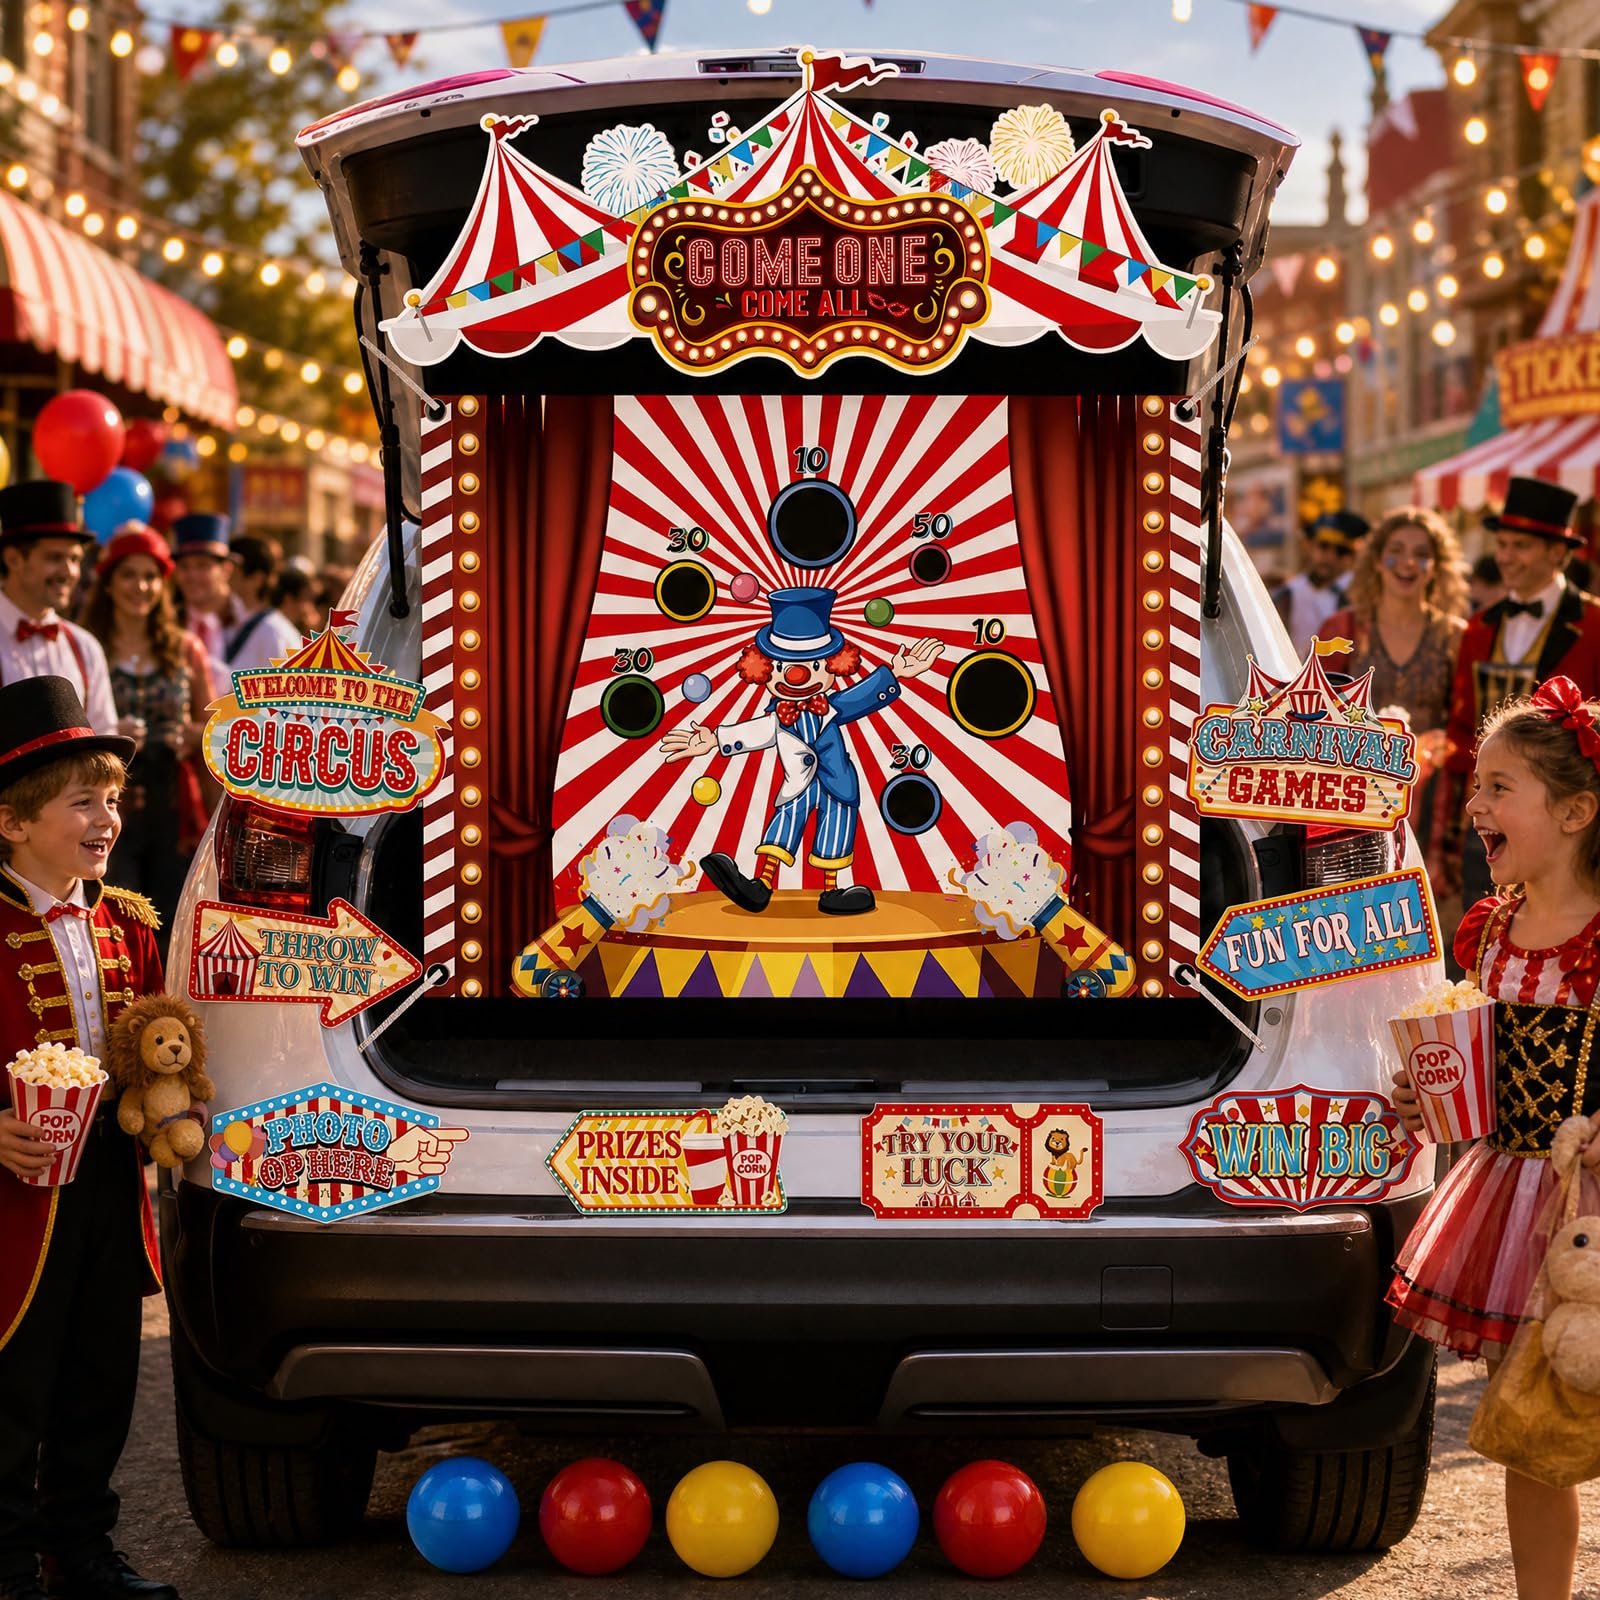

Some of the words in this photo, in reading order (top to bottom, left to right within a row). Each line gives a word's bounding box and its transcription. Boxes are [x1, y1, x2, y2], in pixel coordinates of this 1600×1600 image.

[688, 237, 822, 287] COME
[835, 236, 928, 286] ONE
[741, 290, 809, 317] COME
[818, 290, 868, 317] ALL
[794, 447, 828, 473] 10
[912, 512, 953, 539] 50
[667, 527, 709, 553] 30
[972, 618, 1007, 645] 10
[613, 648, 654, 673] 30
[241, 675, 337, 700] WELCOME
[342, 679, 369, 703] TO
[372, 684, 417, 714] THE
[223, 718, 421, 796] CIRCUS
[889, 744, 932, 770] 30
[1196, 716, 1414, 778] CARNIVAL
[1228, 766, 1368, 813] GAMES
[258, 928, 382, 966] THROW
[1223, 925, 1286, 973] FUN
[1292, 911, 1357, 958] FOR
[1362, 897, 1423, 944] ALL
[257, 960, 301, 989] TO
[309, 963, 375, 997] WIN
[1415, 1049, 1451, 1069] POP
[1416, 1065, 1460, 1086] CORN
[39, 1114, 74, 1129] POP
[263, 1110, 392, 1154] PHOTO
[40, 1129, 76, 1143] ORN
[576, 1130, 682, 1160] PRIZES
[882, 1131, 936, 1157] TRY
[937, 1131, 1014, 1157] YOUR
[1207, 1122, 1308, 1178] WIN
[1318, 1122, 1393, 1178] BIG
[258, 1152, 305, 1191] OP
[306, 1150, 395, 1192] HERE
[737, 1164, 767, 1174] CORN
[740, 1154, 763, 1164] POP
[901, 1157, 992, 1187] LUCK
[579, 1165, 679, 1195] INSIDE
